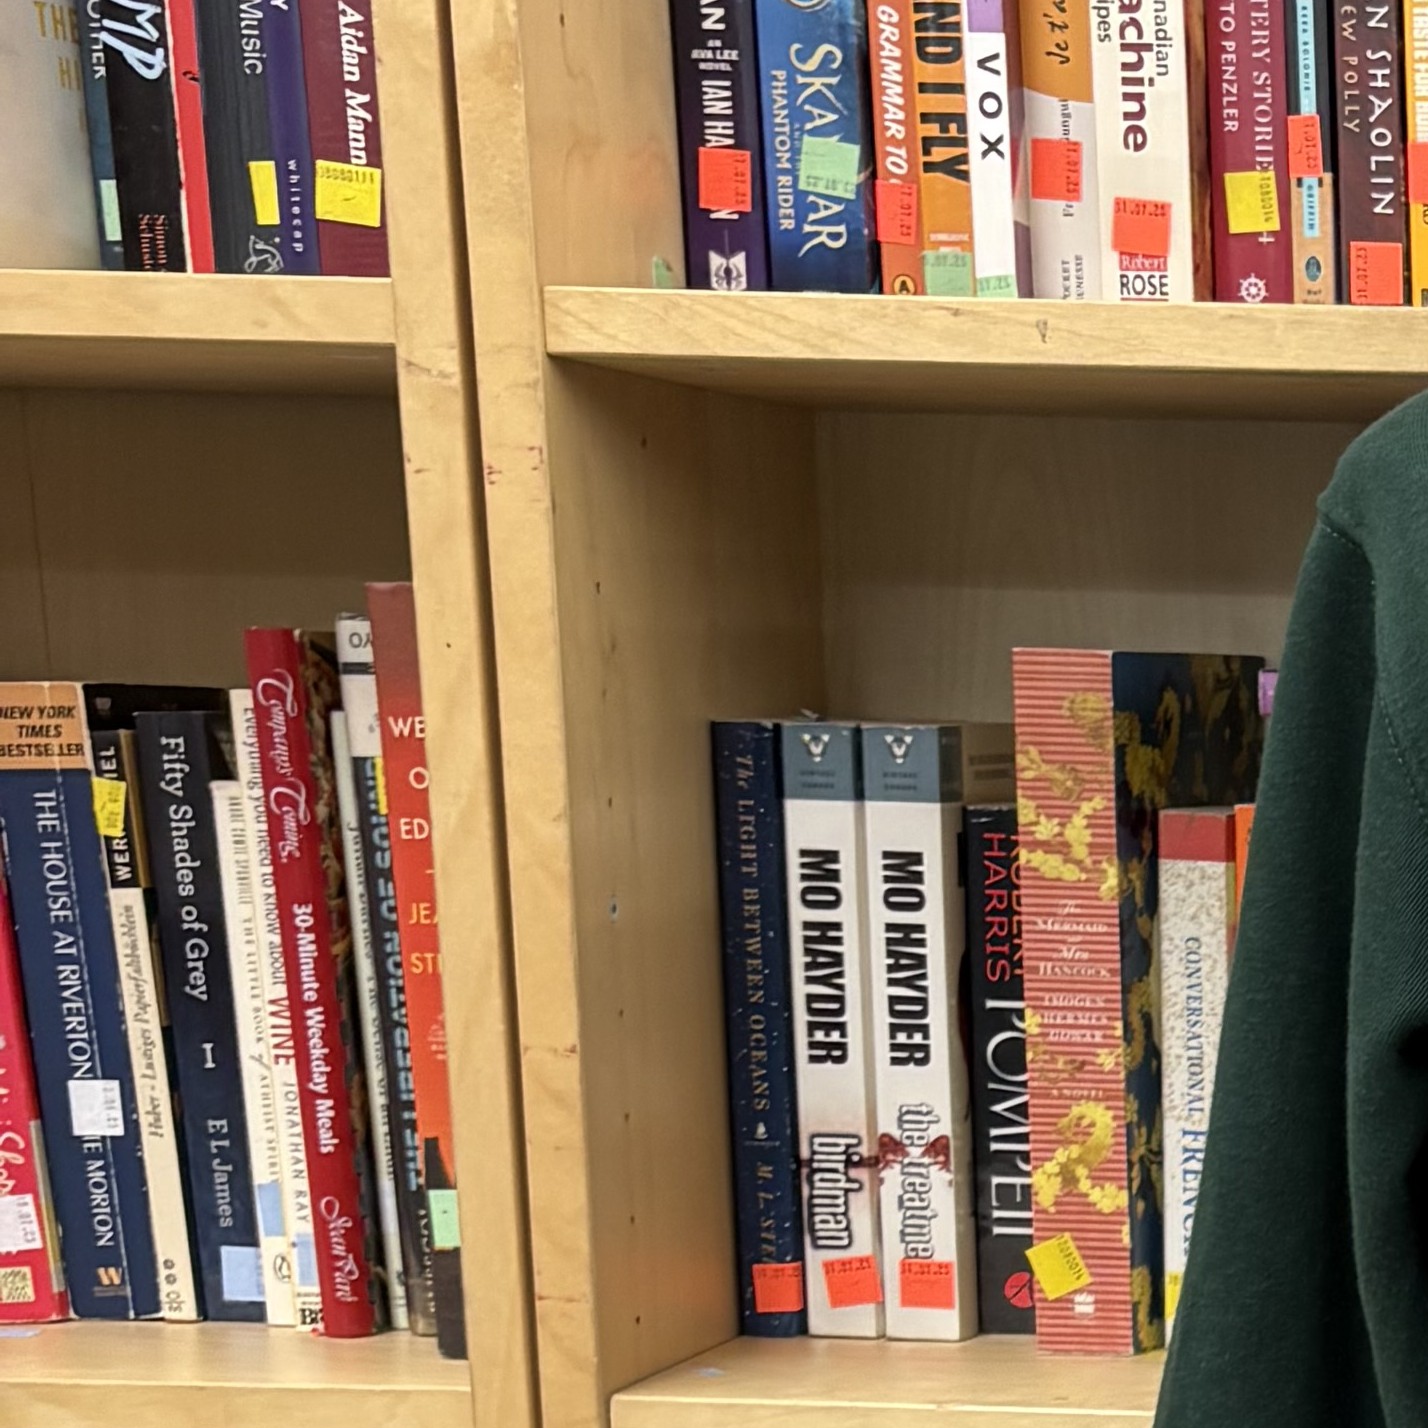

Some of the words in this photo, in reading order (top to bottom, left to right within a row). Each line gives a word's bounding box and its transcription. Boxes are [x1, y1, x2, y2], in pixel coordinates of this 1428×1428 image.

[338, 1, 366, 83] Aidan
[344, 87, 372, 166] Mann
[771, 70, 791, 169] PHANTOM
[976, 50, 1006, 161] VOX
[1221, 41, 1240, 134] PENZLER
[1342, 52, 1360, 134] POLLY
[1366, 49, 1395, 216] SHAOLIN
[778, 172, 795, 231] RIDER
[1120, 274, 1169, 296] ROSE
[16, 724, 62, 739] TIMES
[37, 705, 75, 719] YORK
[160, 736, 184, 798] Fifty
[33, 790, 59, 833] THE
[168, 805, 194, 897] Shades
[41, 843, 73, 921] HOUSE
[183, 904, 207, 932] of
[798, 847, 843, 911] MO
[882, 850, 926, 912] MO
[982, 832, 1009, 983] HARRIS
[53, 927, 74, 962] AT
[186, 937, 211, 1001] Grey
[292, 903, 318, 1002] 30-Minute
[1039, 963, 1111, 980] HANCOCK
[58, 965, 94, 1077] RIVERTON
[803, 922, 848, 1065] HAYDER
[886, 923, 931, 1066] HAYDER
[304, 1007, 332, 1095] Weekday
[314, 1098, 335, 1155] Meals
[809, 1133, 861, 1249] birdman
